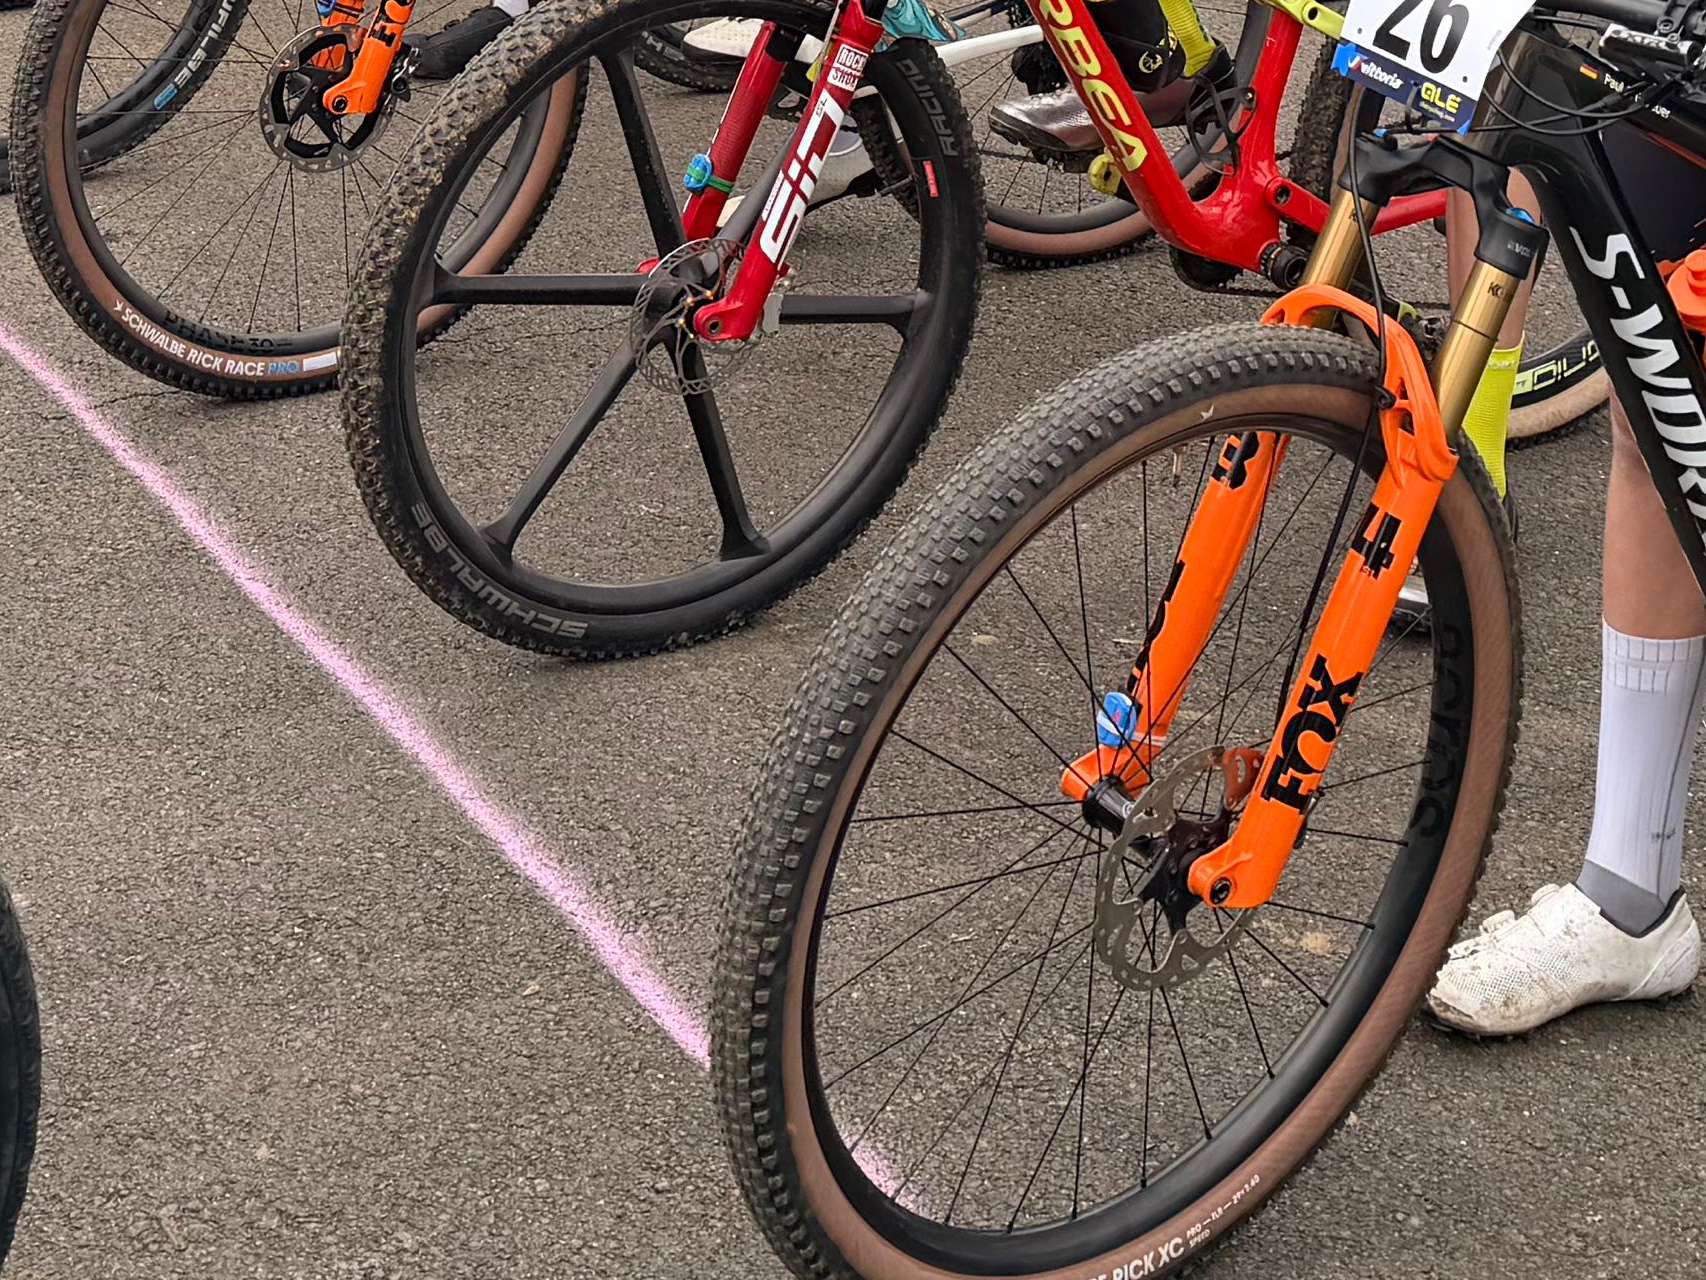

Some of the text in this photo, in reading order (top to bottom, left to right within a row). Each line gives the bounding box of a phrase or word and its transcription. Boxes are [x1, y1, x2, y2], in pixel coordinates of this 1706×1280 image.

[1361, 60, 1403, 91] vittoria
[1603, 73, 1625, 93] Paul
[121, 300, 186, 361] SCHWALBE
[187, 348, 224, 373] RICK
[225, 357, 267, 378] RACE
[1262, 653, 1364, 816] FOX
[1158, 1236, 1185, 1268] XC
